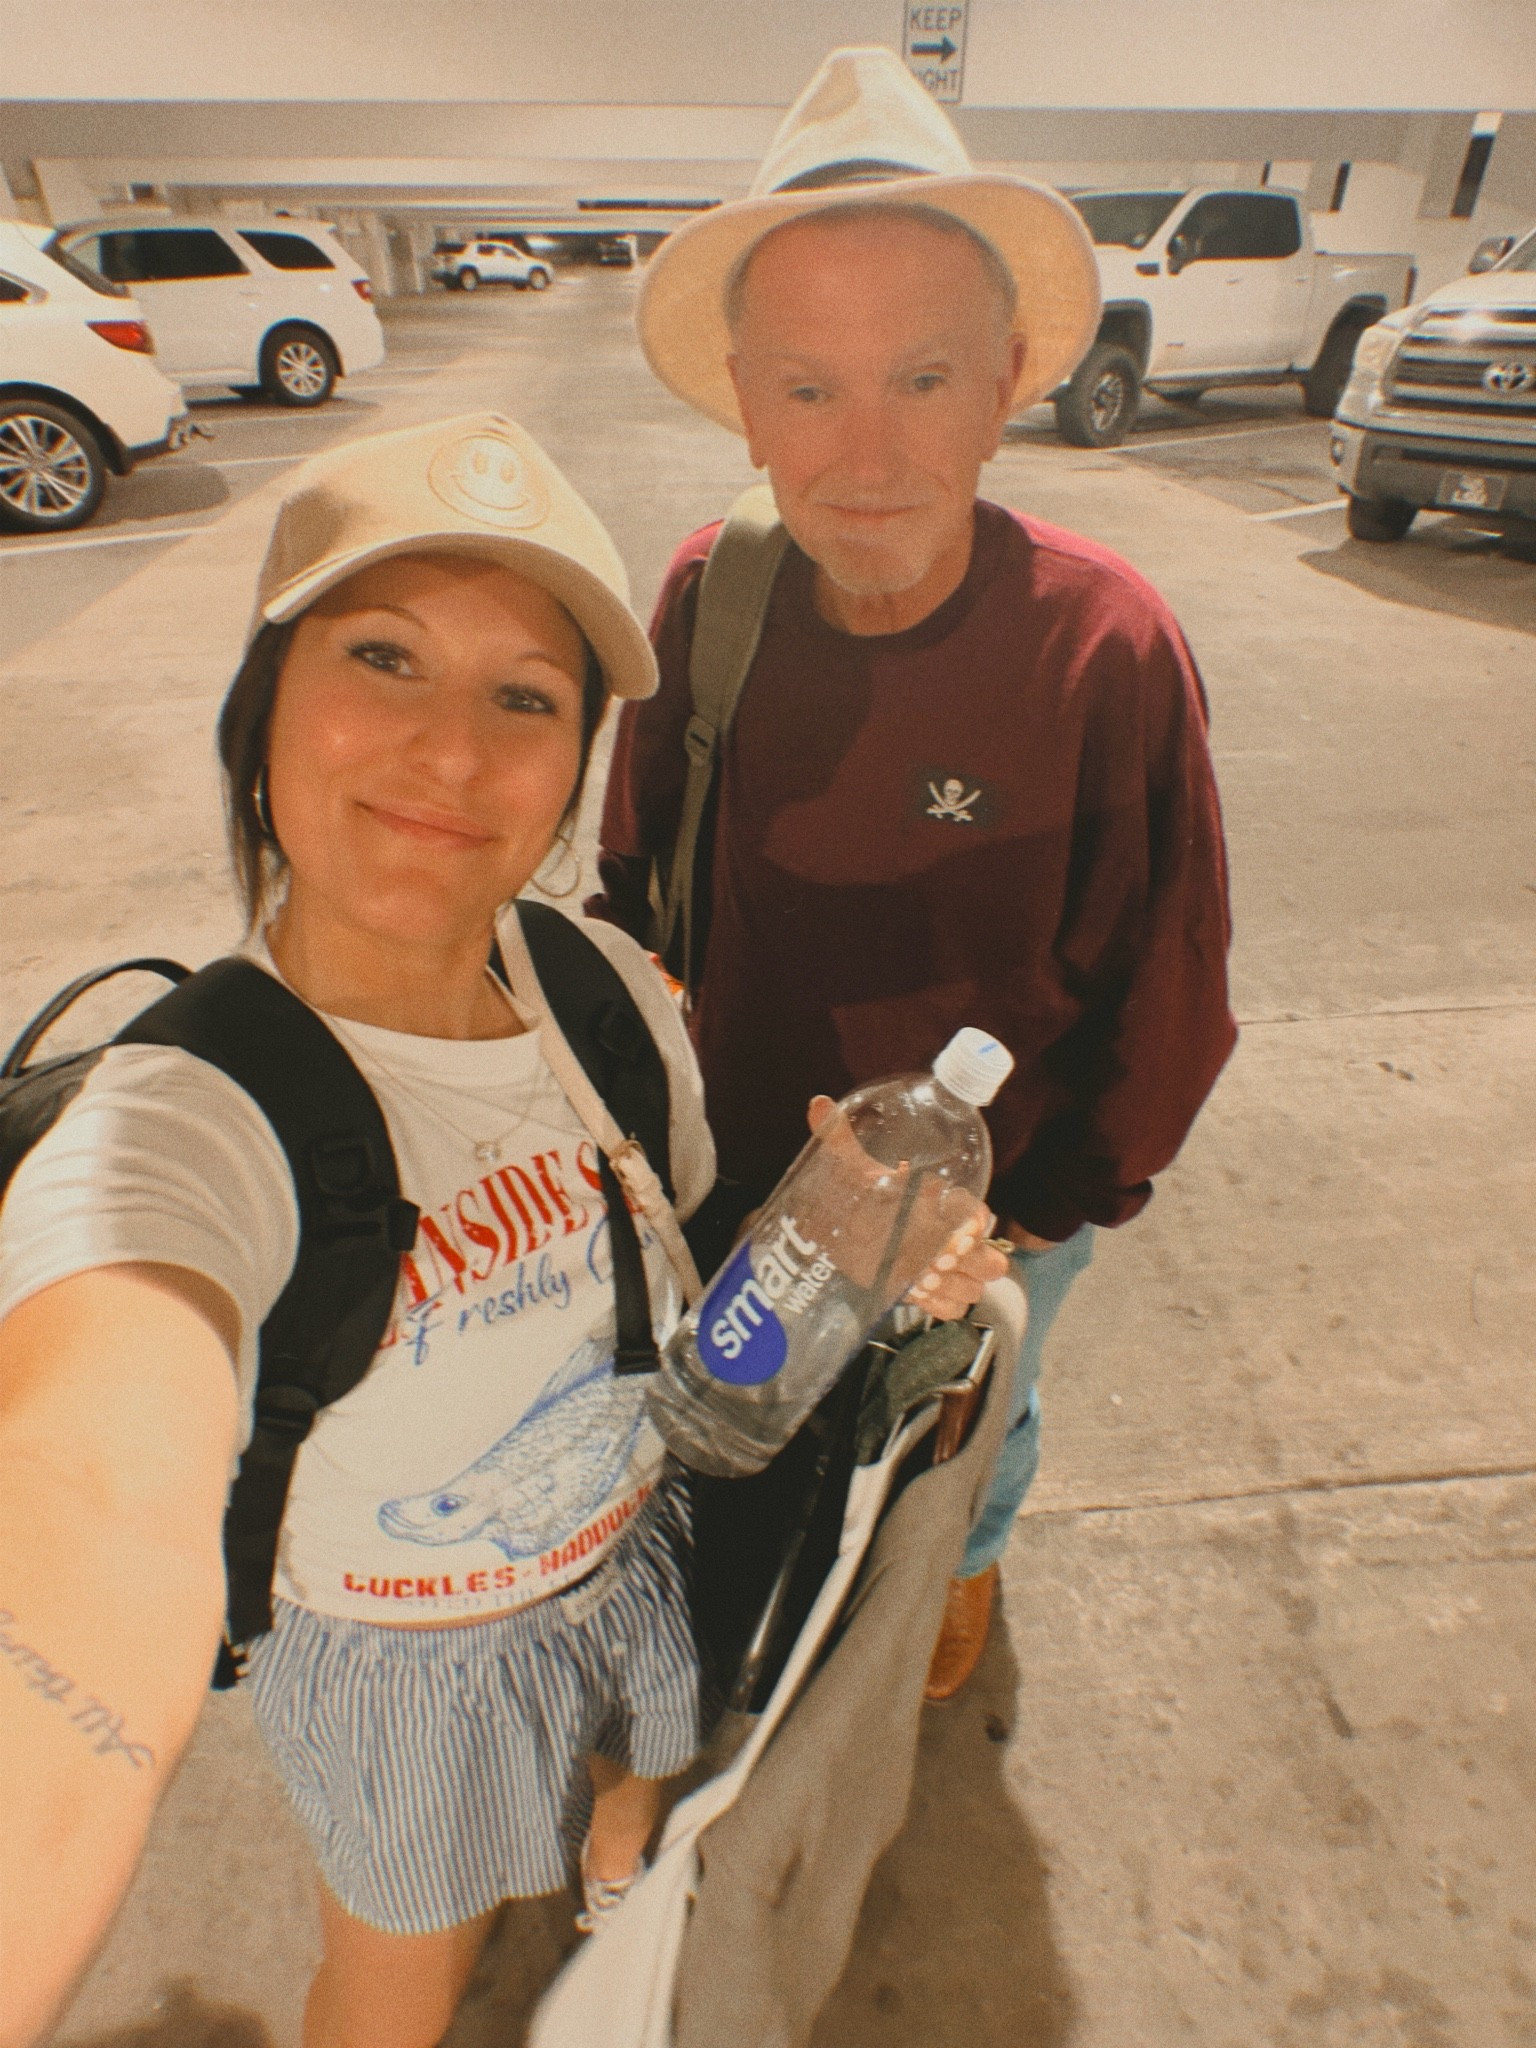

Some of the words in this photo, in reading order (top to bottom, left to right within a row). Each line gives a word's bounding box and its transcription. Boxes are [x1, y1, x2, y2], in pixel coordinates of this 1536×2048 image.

[910, 6, 961, 30] KEEP
[912, 67, 958, 91] GHT
[405, 1253, 571, 1366] Freshly
[709, 1214, 817, 1360] smart
[783, 1252, 837, 1313] water
